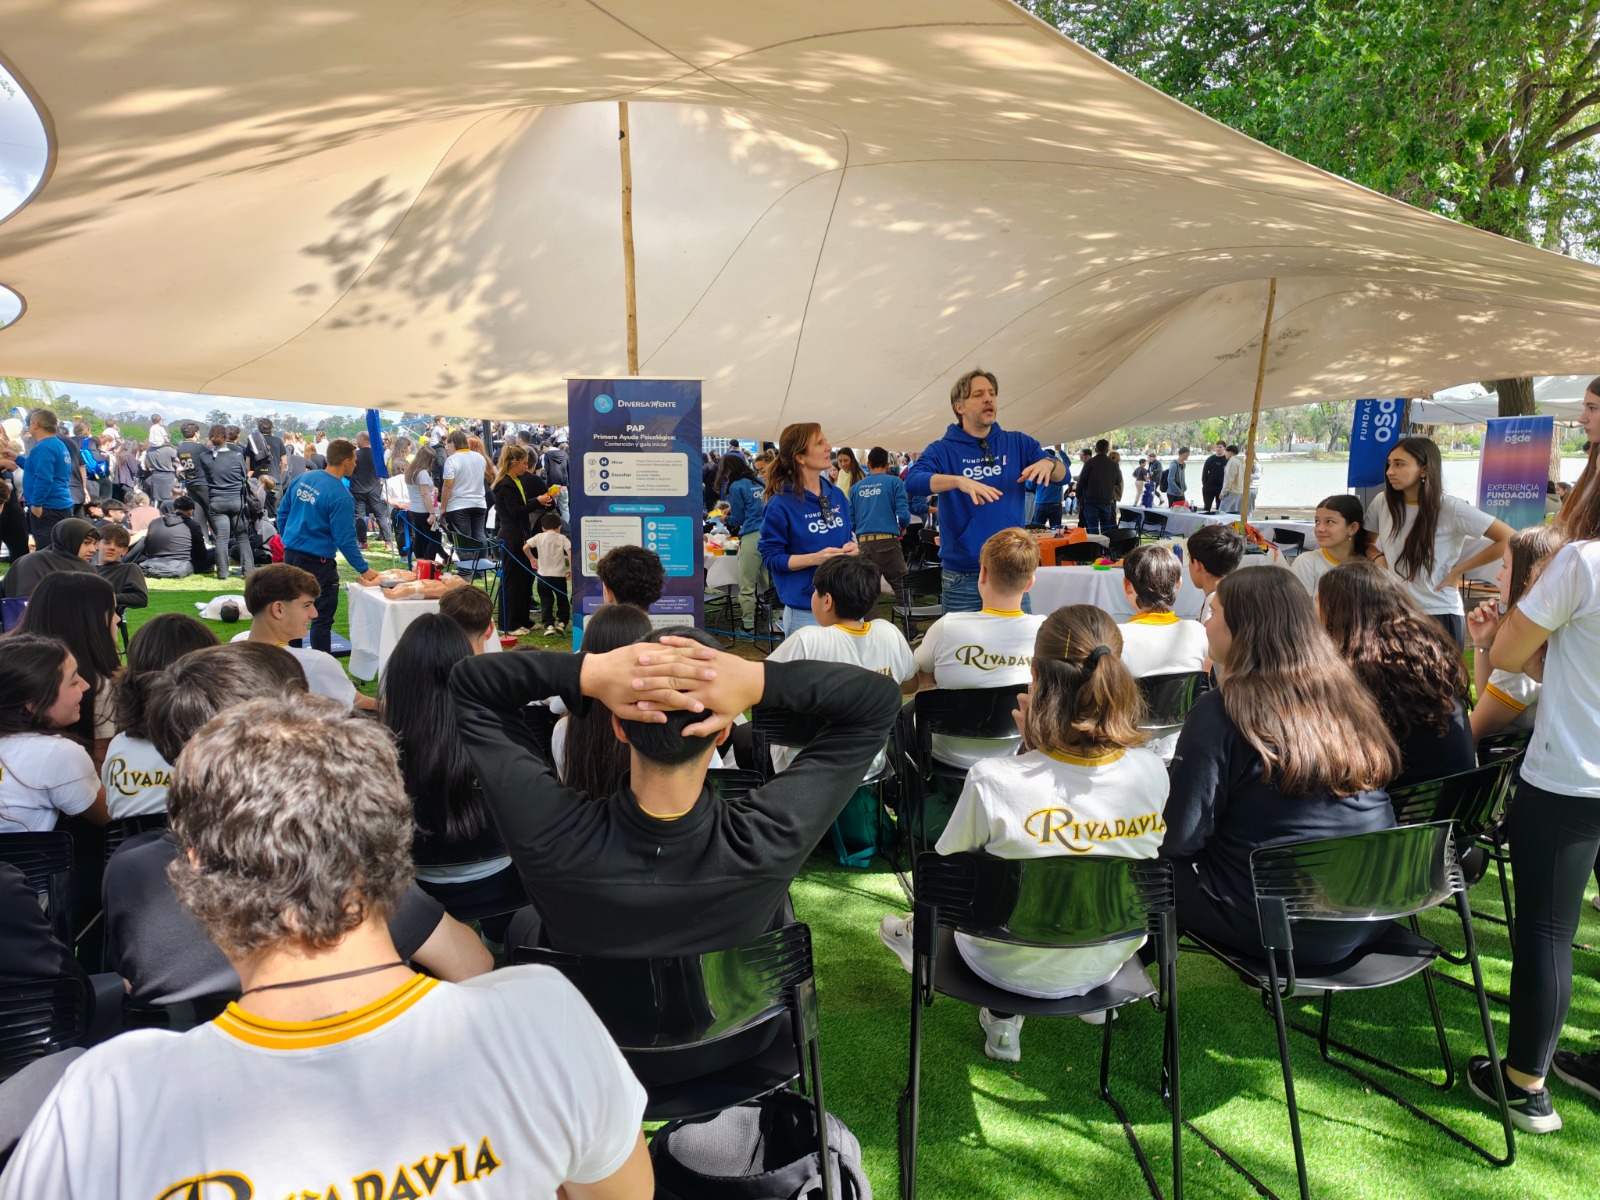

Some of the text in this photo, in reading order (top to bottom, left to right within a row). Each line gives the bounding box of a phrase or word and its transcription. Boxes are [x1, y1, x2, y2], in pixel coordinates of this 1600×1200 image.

[1360, 400, 1372, 441] FUNDAC
[1374, 398, 1397, 443] osd
[1504, 434, 1532, 445] osde
[181, 458, 195, 470] 26
[962, 464, 1002, 480] osde
[859, 487, 881, 498] osde
[1486, 490, 1540, 499] FUNDACIÓN
[1487, 483, 1540, 491] EXPERIENCIA
[1486, 499, 1511, 507] OSDE
[955, 644, 1033, 672] RIVADAV
[107, 757, 171, 797] RIVADA
[1024, 806, 1166, 855] RIVADAVIA
[154, 1136, 502, 1200] DAVIA
